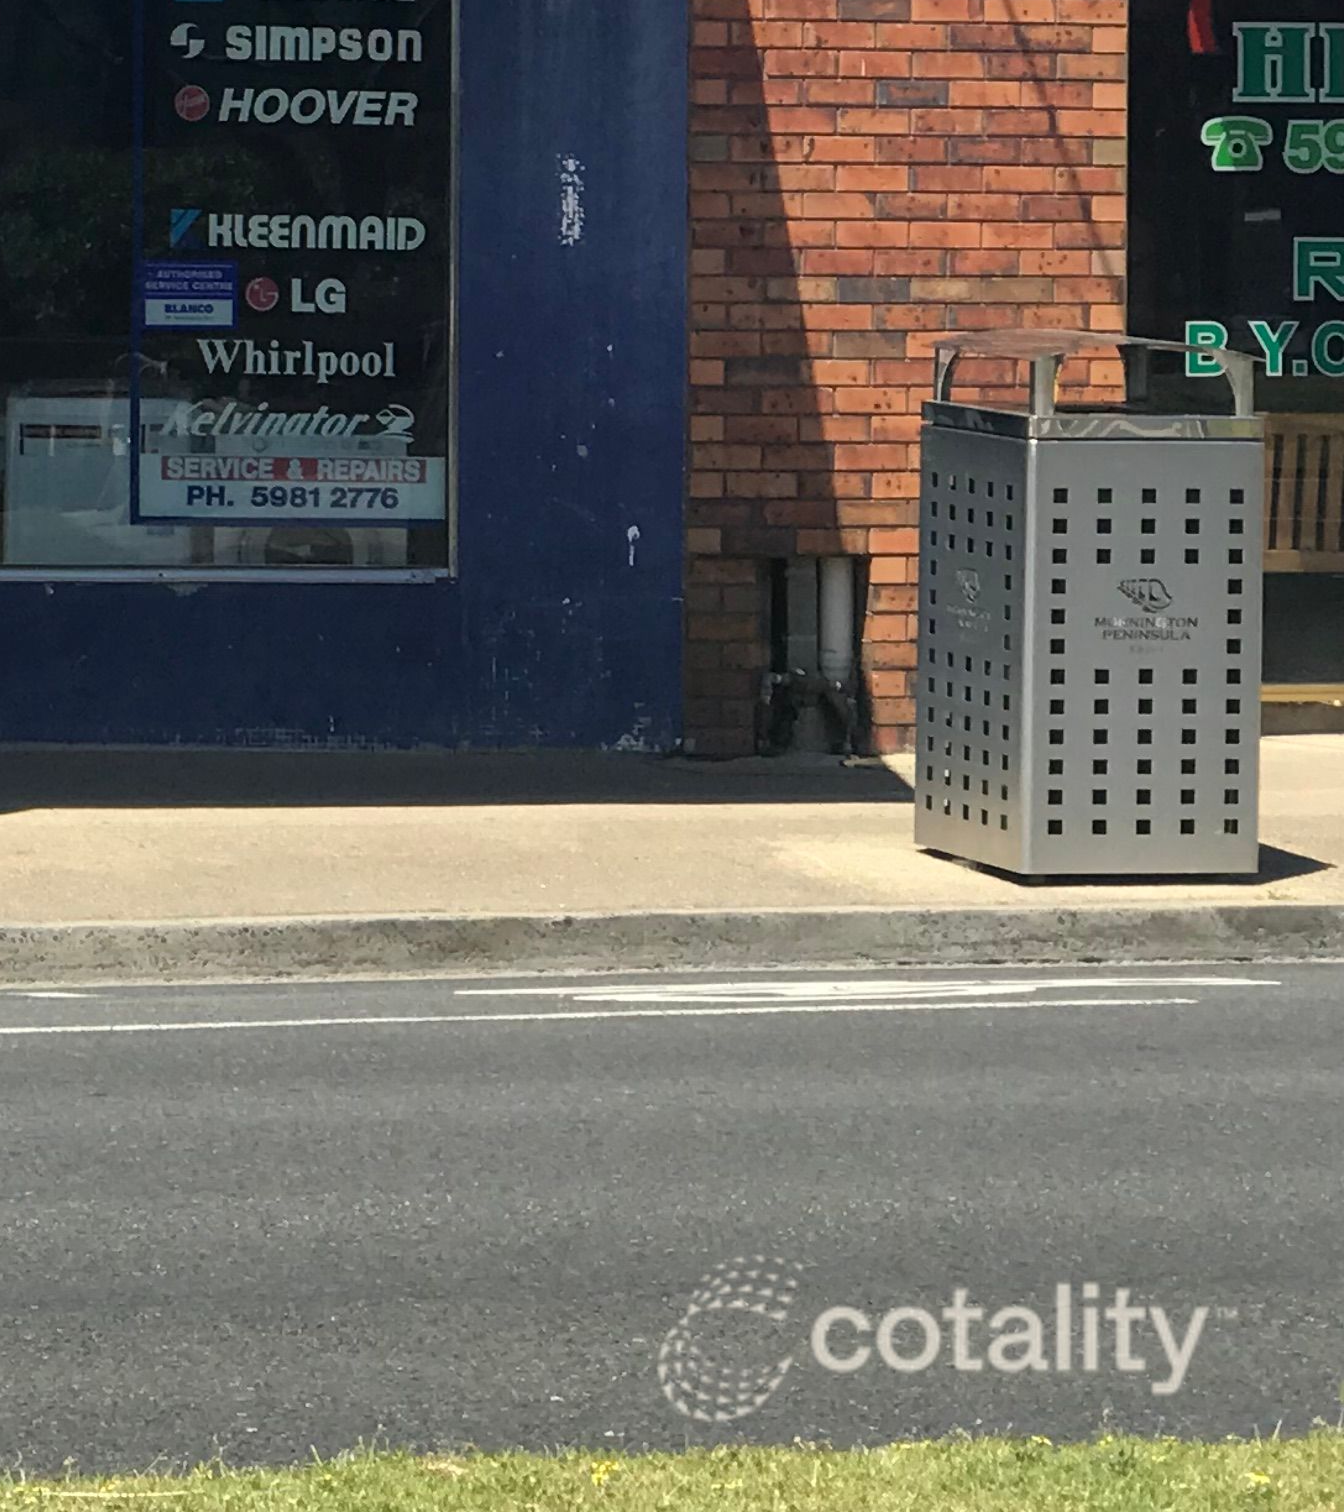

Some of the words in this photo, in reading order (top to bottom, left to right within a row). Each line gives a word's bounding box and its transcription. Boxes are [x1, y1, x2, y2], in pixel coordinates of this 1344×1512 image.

[226, 25, 423, 62] SIMPSON
[218, 88, 419, 126] HOOVER
[208, 214, 426, 251] KLEENMAID
[291, 278, 347, 314] LG
[197, 339, 396, 384] Whirlpool
[162, 402, 370, 438] Kelvinator
[167, 457, 274, 479] SERVICE
[286, 460, 305, 480] &
[317, 458, 421, 482] REPAIRS
[187, 485, 234, 507] PH.
[250, 486, 320, 508] 5981
[330, 488, 398, 509] 2776
[1102, 629, 1192, 640] PENINSULA
